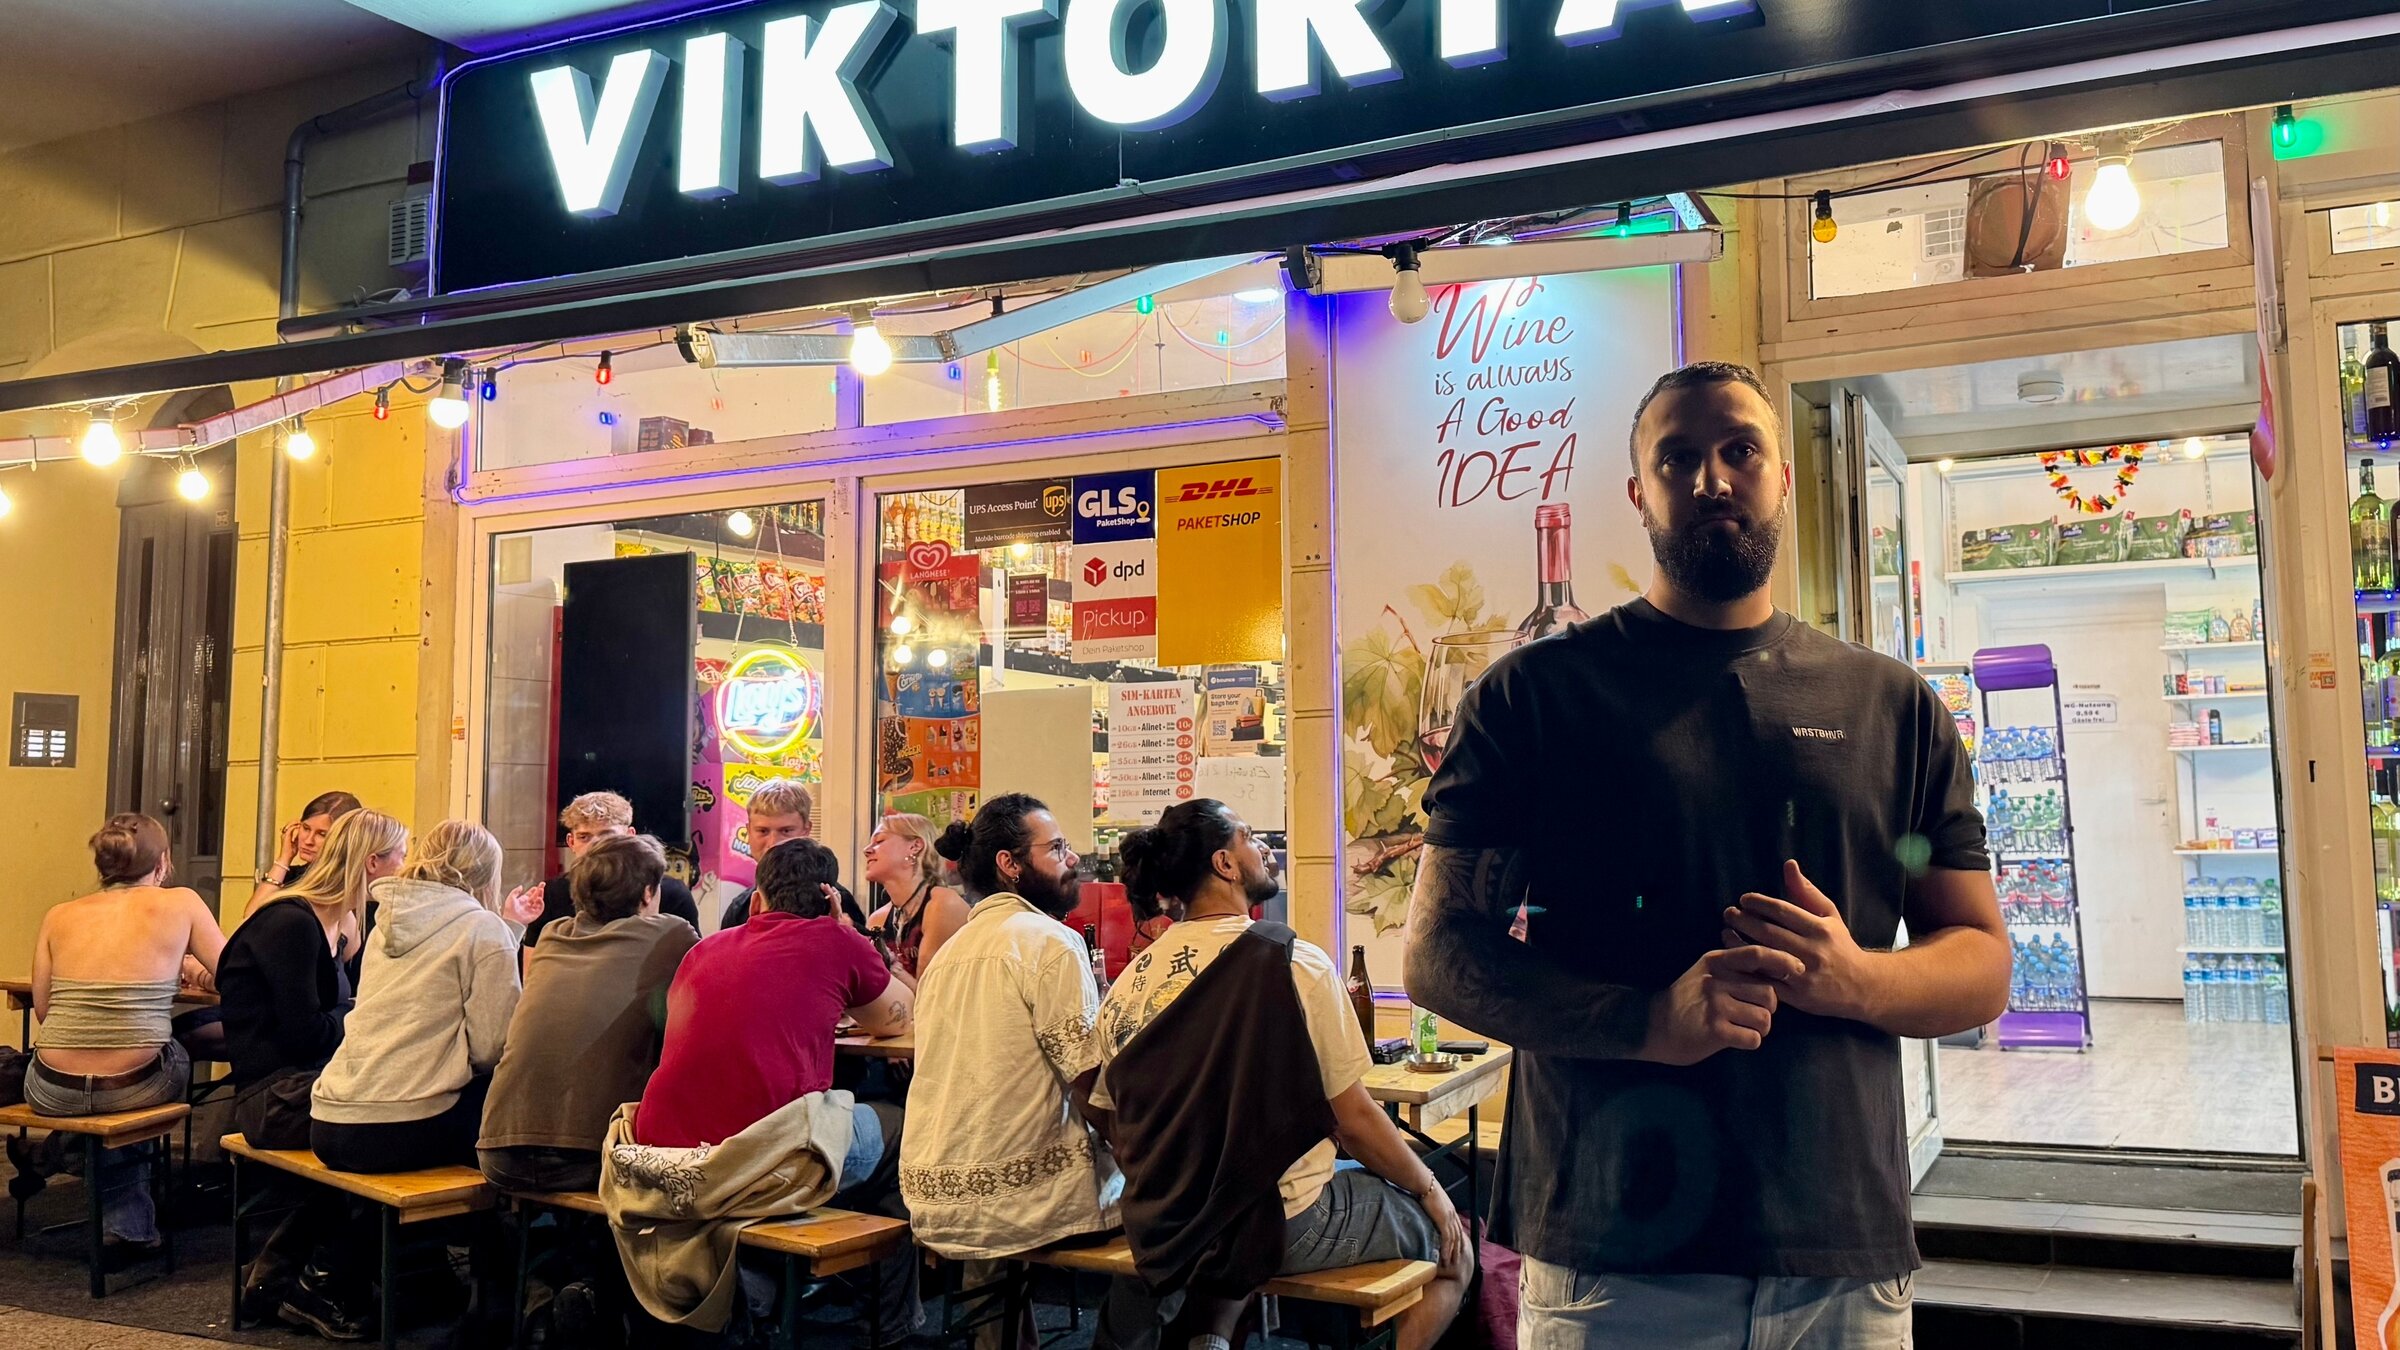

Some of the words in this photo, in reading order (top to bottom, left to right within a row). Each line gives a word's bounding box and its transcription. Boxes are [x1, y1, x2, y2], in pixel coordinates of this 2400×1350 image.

[1434, 279, 1574, 363] Wine
[1435, 371, 1456, 395] is
[1467, 357, 1574, 391] always
[1437, 397, 1465, 443] A
[1477, 396, 1576, 436] Good
[1437, 432, 1577, 508] IDEA
[1178, 477, 1259, 502] DHL
[969, 504, 986, 515] UPS
[987, 503, 1013, 514] Access
[1014, 499, 1037, 511] Point
[1045, 494, 1065, 513] ups
[1077, 486, 1137, 518] GLS
[1096, 517, 1136, 527] PaketShop
[1177, 511, 1261, 531] PAKETSHOP
[994, 533, 1015, 541] barcode
[1015, 531, 1039, 540] shipping
[1039, 528, 1061, 537] enabled
[910, 569, 947, 580] LANGNESE
[1113, 559, 1145, 581] dpd
[1083, 608, 1145, 629] Pickup
[1082, 646, 1101, 655] Dein
[1102, 643, 1145, 654] Paketshop
[1121, 687, 1182, 701] SIM-KARTEN
[1126, 704, 1177, 717] ANGEBOTE
[1141, 722, 1162, 732] Allnet
[1141, 739, 1162, 748] Allnet
[1141, 755, 1162, 765] Allnet
[1141, 772, 1162, 781] Allnet
[1142, 787, 1171, 797] Internet
[1166, 945, 1199, 979] 武
